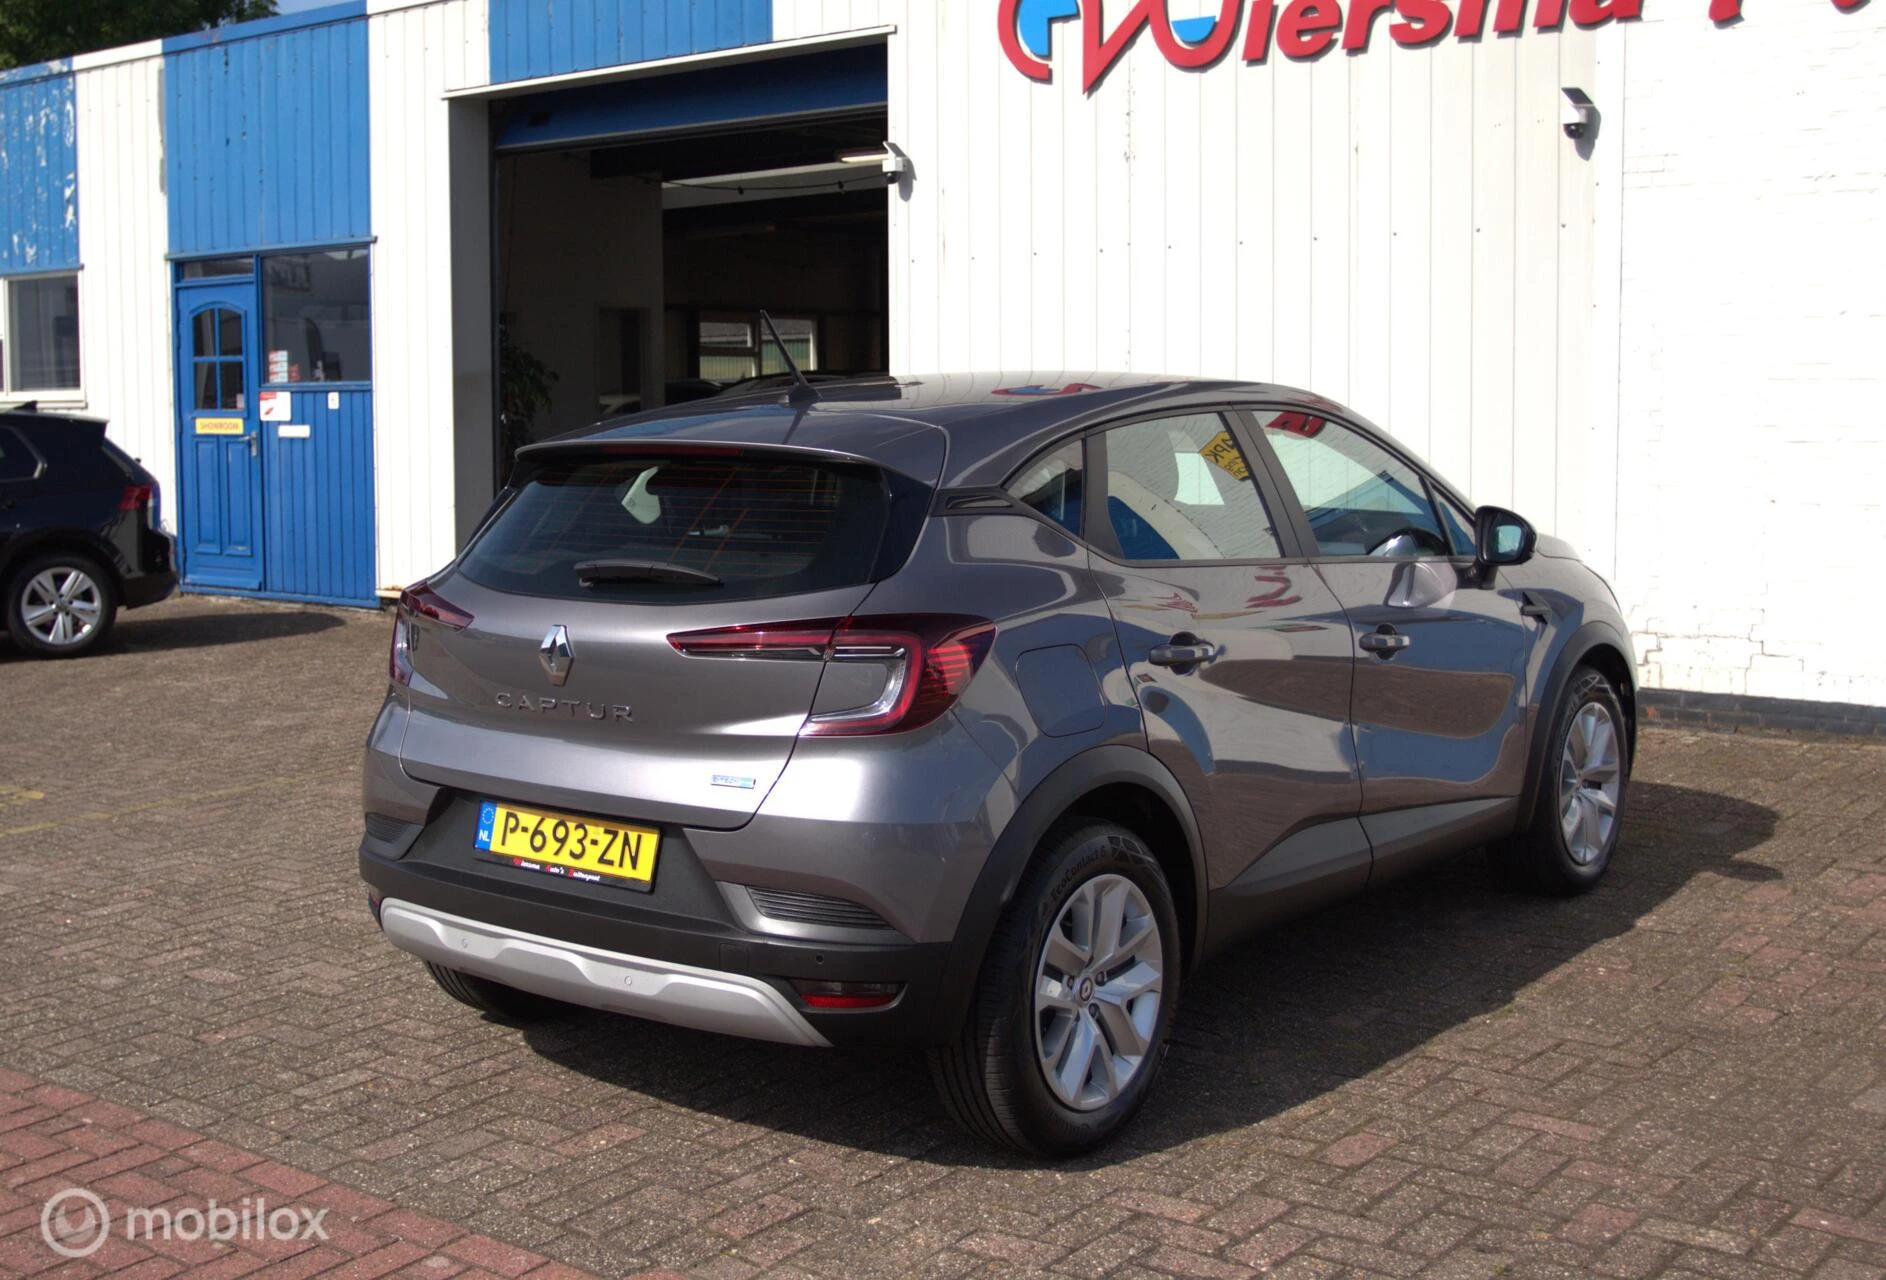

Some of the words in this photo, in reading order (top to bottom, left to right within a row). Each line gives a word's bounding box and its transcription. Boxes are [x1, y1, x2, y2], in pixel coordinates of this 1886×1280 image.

[495, 692, 633, 722] CAPTUR
[478, 829, 490, 842] NL
[501, 811, 643, 871] P-693-ZN
